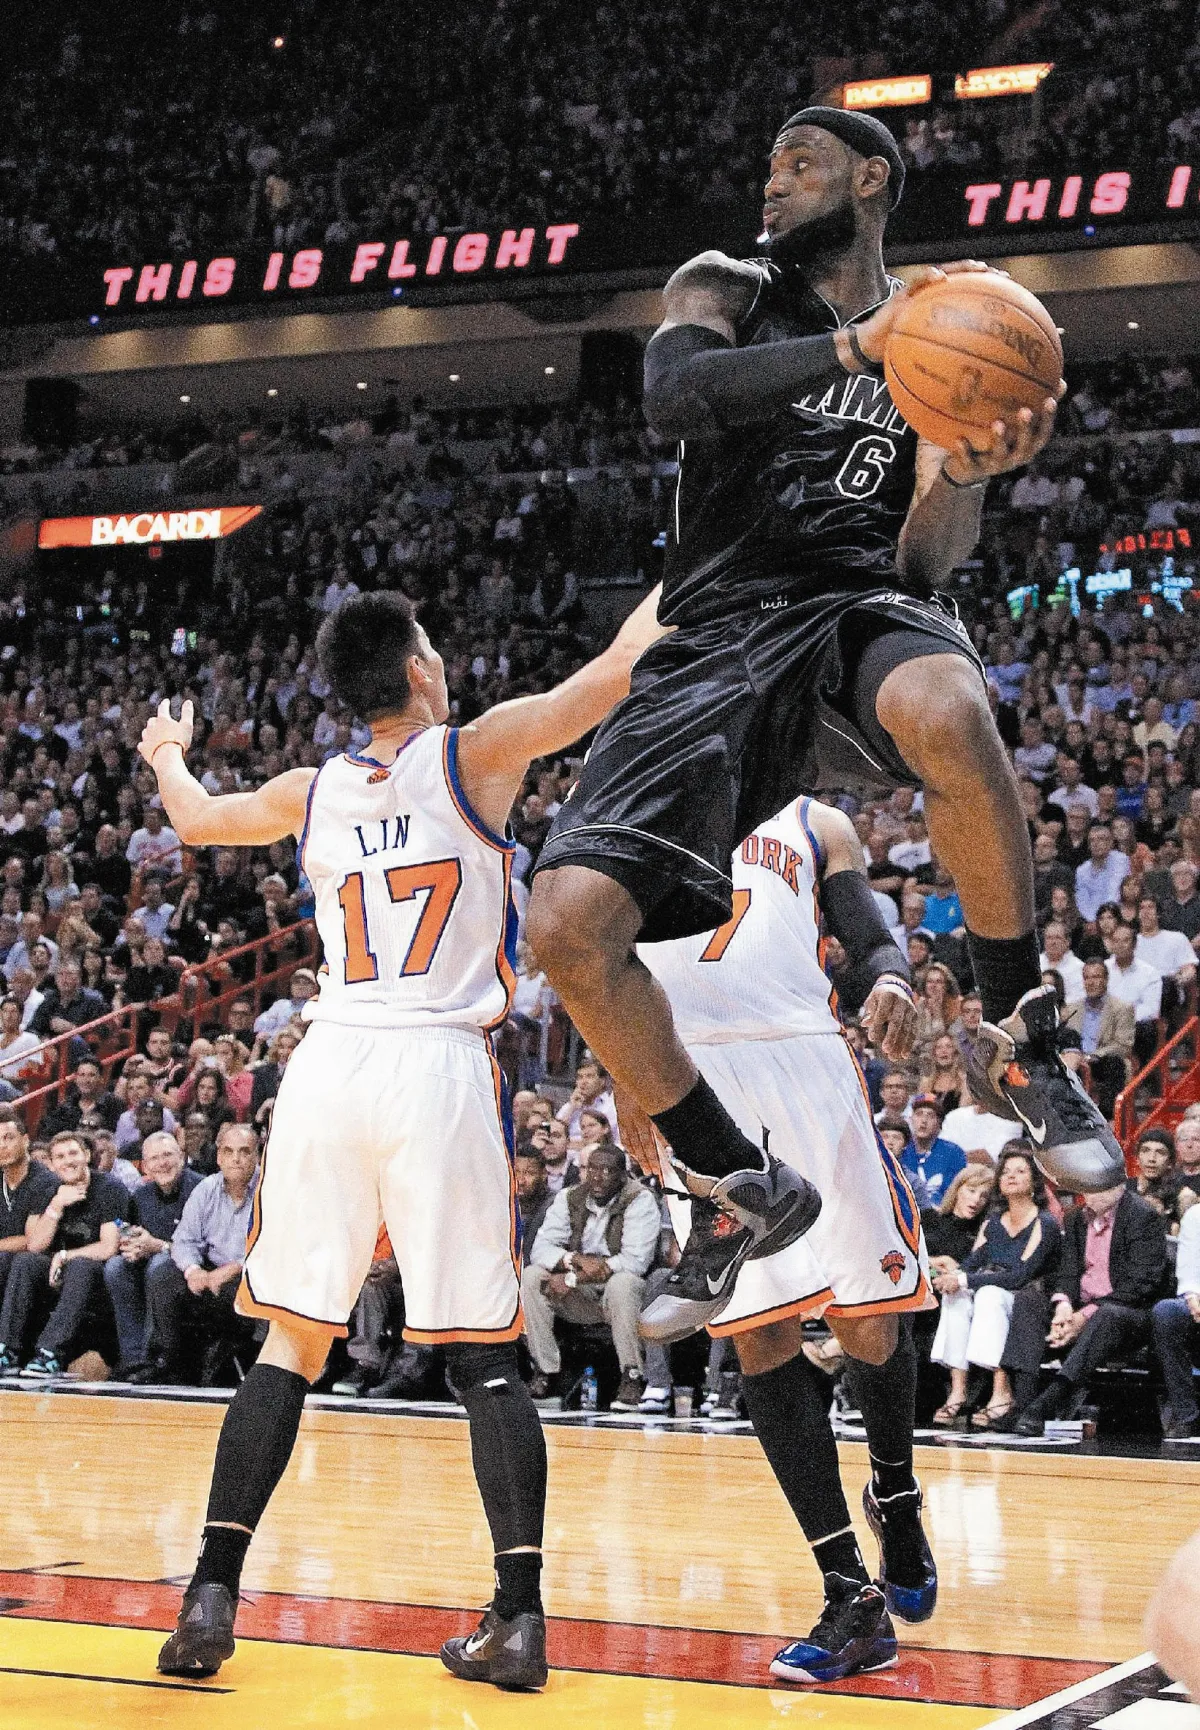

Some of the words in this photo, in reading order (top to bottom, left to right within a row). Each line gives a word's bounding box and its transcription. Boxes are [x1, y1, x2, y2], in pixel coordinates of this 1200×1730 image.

[965, 171, 1131, 226] THIS
[1166, 165, 1200, 208] I
[103, 257, 237, 306] THIS
[262, 248, 323, 291] IS
[350, 223, 580, 283] FLIGHT
[835, 434, 897, 500] 6
[90, 510, 221, 546] BACARDI
[354, 814, 411, 857] LIN
[740, 834, 803, 897] ORK
[337, 857, 463, 985] 17
[698, 888, 752, 962] 7
